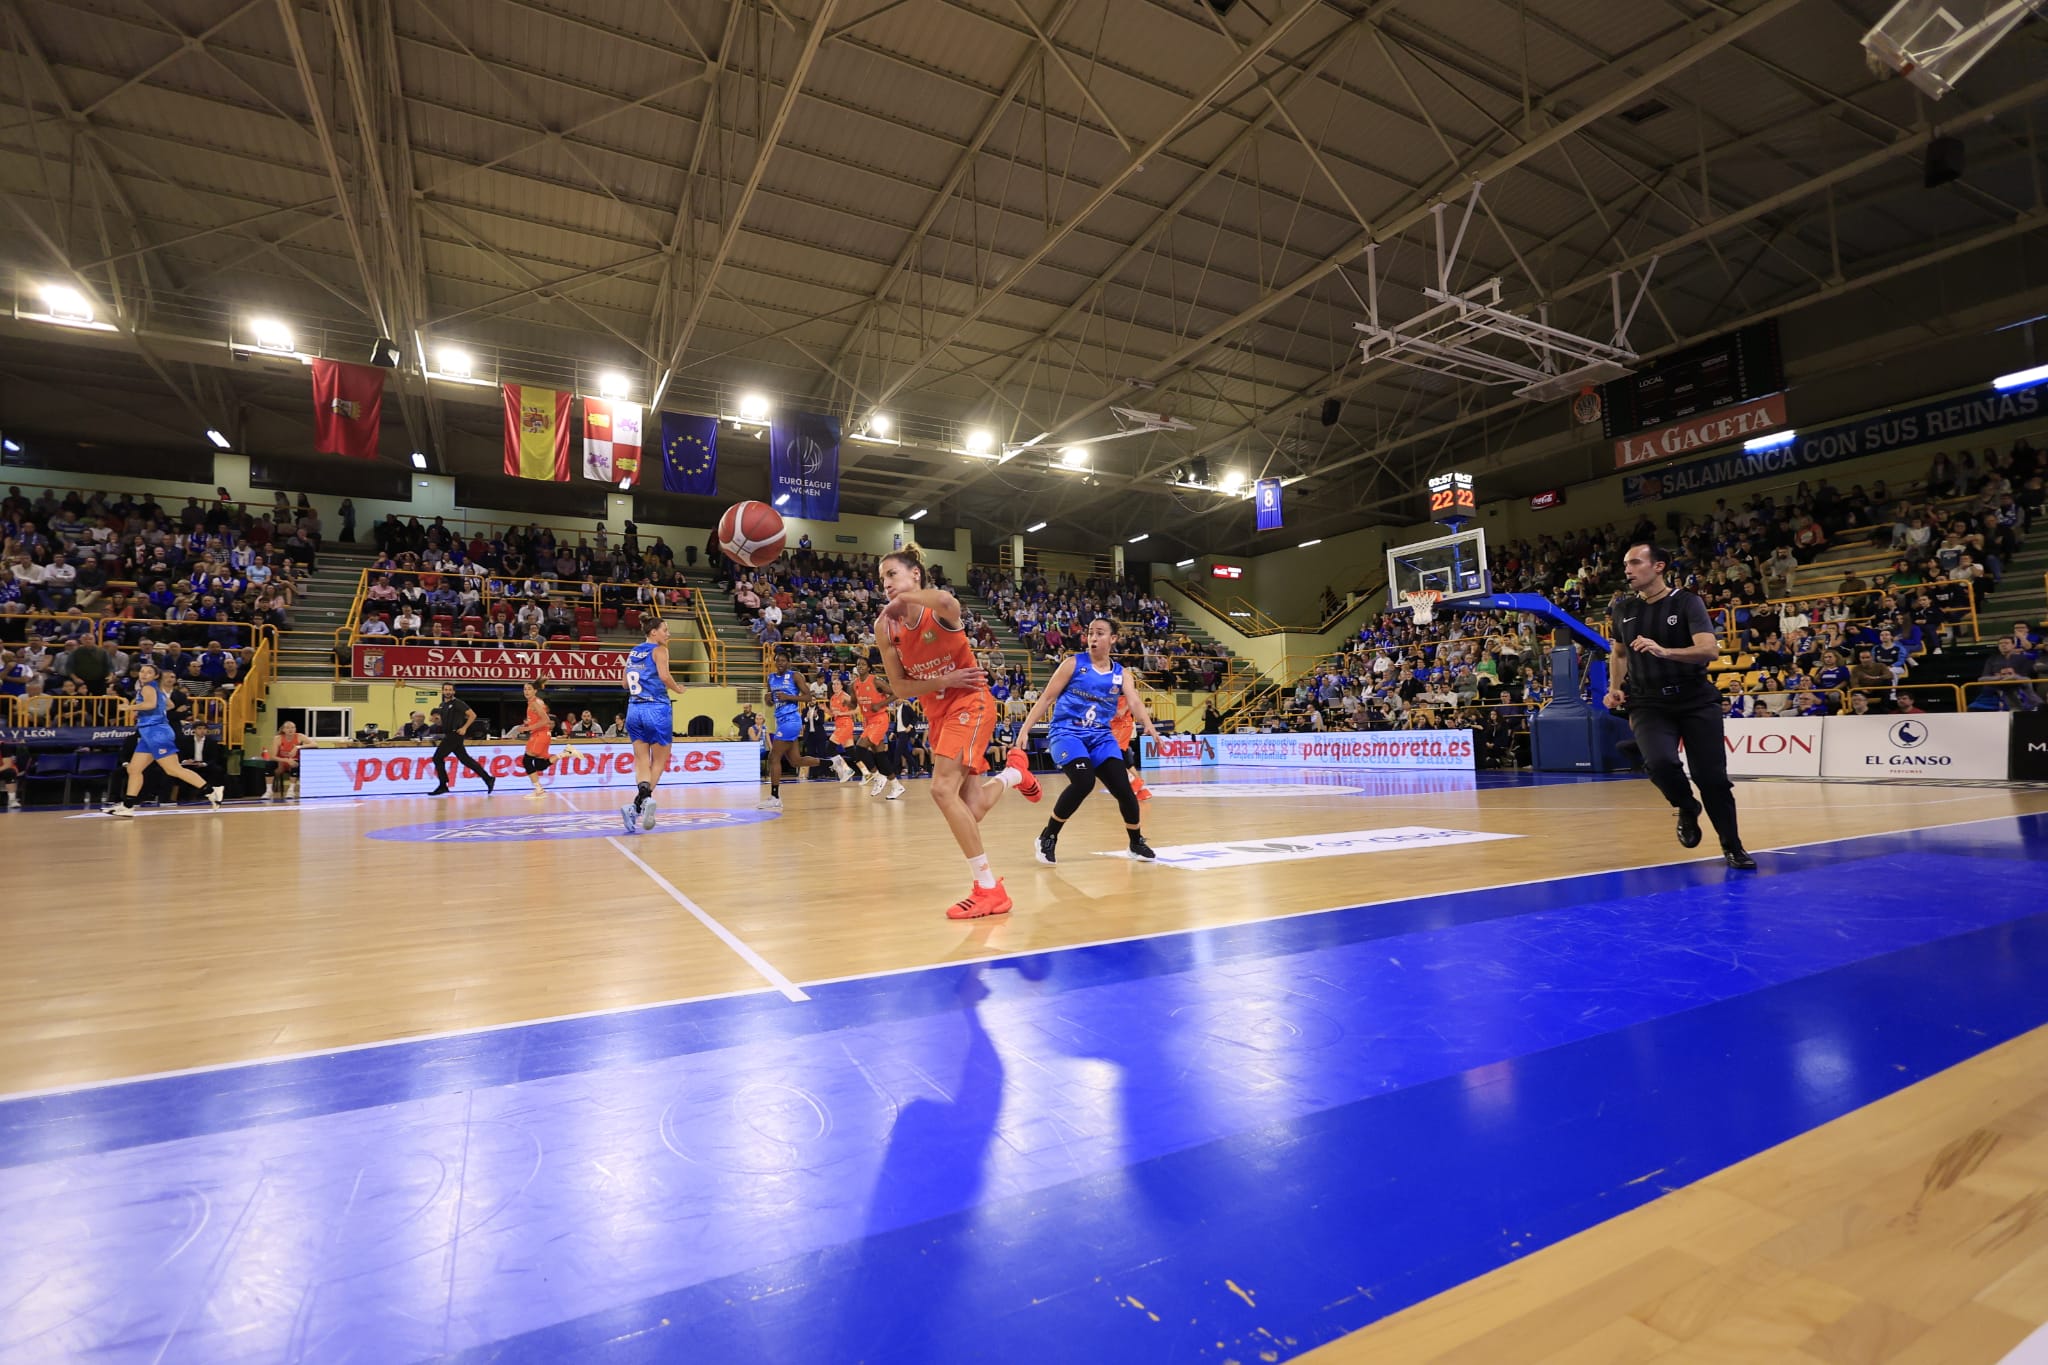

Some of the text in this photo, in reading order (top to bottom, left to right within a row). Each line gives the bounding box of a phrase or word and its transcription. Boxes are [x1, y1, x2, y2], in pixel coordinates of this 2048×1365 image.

[1638, 375, 1664, 388] LOCAL
[1623, 407, 1774, 465] LA GACETA
[1662, 387, 2039, 495] SALAMANCA CON SUS REINAS
[790, 486, 821, 497] WOMEN
[1264, 489, 1274, 508] 8
[1431, 489, 1454, 511] 22
[1456, 488, 1474, 507] 22
[427, 648, 629, 667] SALAMANCA
[391, 664, 627, 681] PATRIMONIO DE LA HUMANI
[626, 671, 643, 695] 8
[1085, 704, 1097, 721] 6
[11, 729, 20, 739] Y
[24, 728, 56, 738] LEÓN
[1146, 737, 1215, 761] MORETA
[1303, 738, 1472, 761] parquesmoreta.es
[2028, 742, 2048, 753] M
[1865, 755, 1952, 767] EL GANSO
